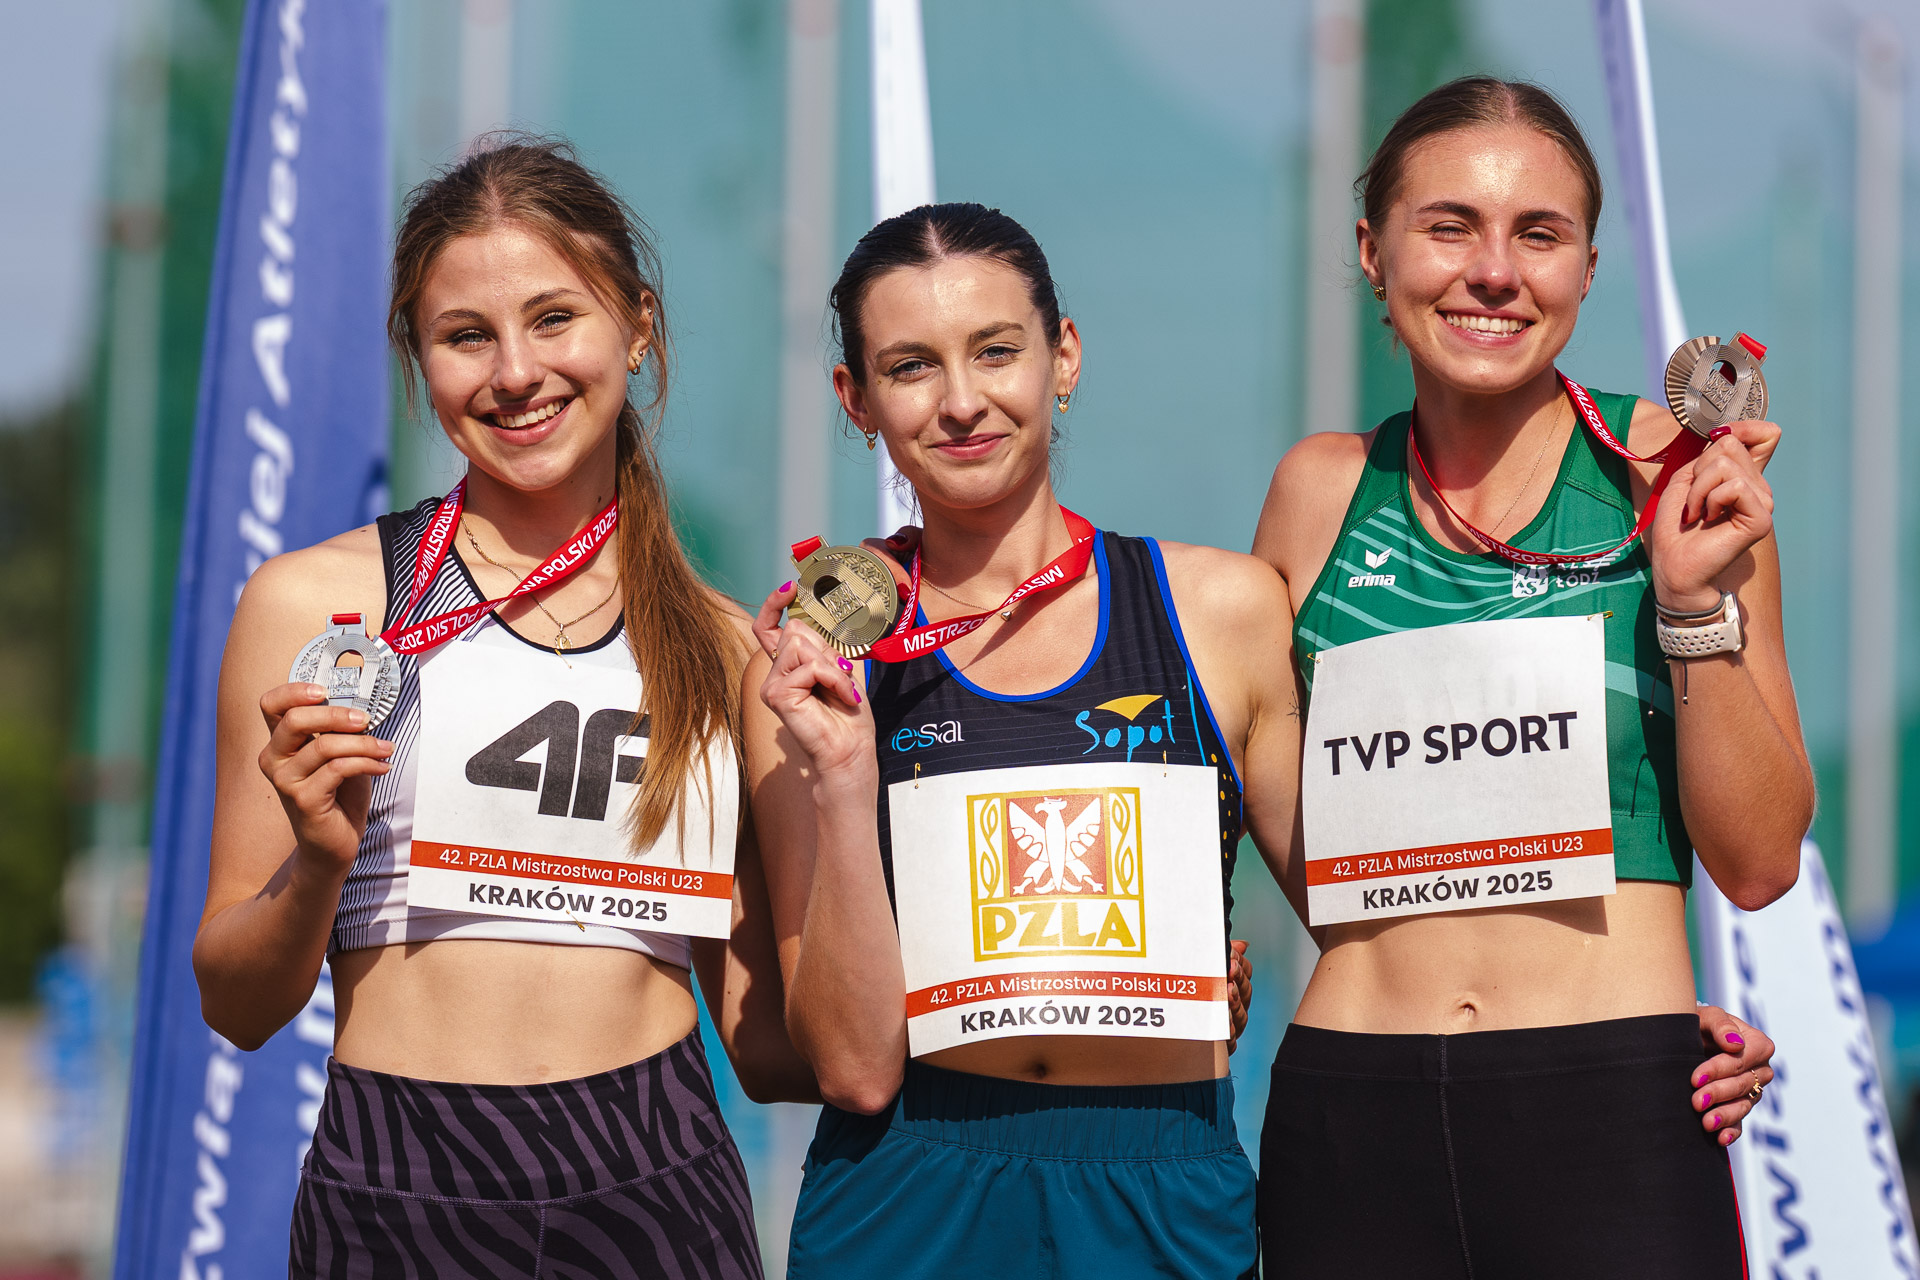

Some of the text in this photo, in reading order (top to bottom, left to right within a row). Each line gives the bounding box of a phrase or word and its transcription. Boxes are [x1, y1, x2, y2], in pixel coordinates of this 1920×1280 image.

[546, 533, 595, 578] POLSKI
[593, 505, 618, 541] 2025
[1348, 572, 1396, 588] erima
[427, 611, 479, 641] POLSKI
[1075, 699, 1175, 762] Sopot
[1324, 711, 1578, 775] TVP SPORT
[465, 700, 651, 821] 4F
[439, 849, 703, 891] 42. PZLA Mistrzostwa Polski U23
[1332, 836, 1584, 877] 42. PZLA Mistrzostwa Polski U23
[469, 883, 668, 922] KRAKÓW 2025
[1363, 870, 1554, 910] KRAKÓW 2025
[981, 901, 1137, 951] PZLA
[930, 977, 1197, 1006] 42. PZLA Mistrzostwa Polski U23
[961, 1000, 1166, 1034] KRAKÓW 2025
